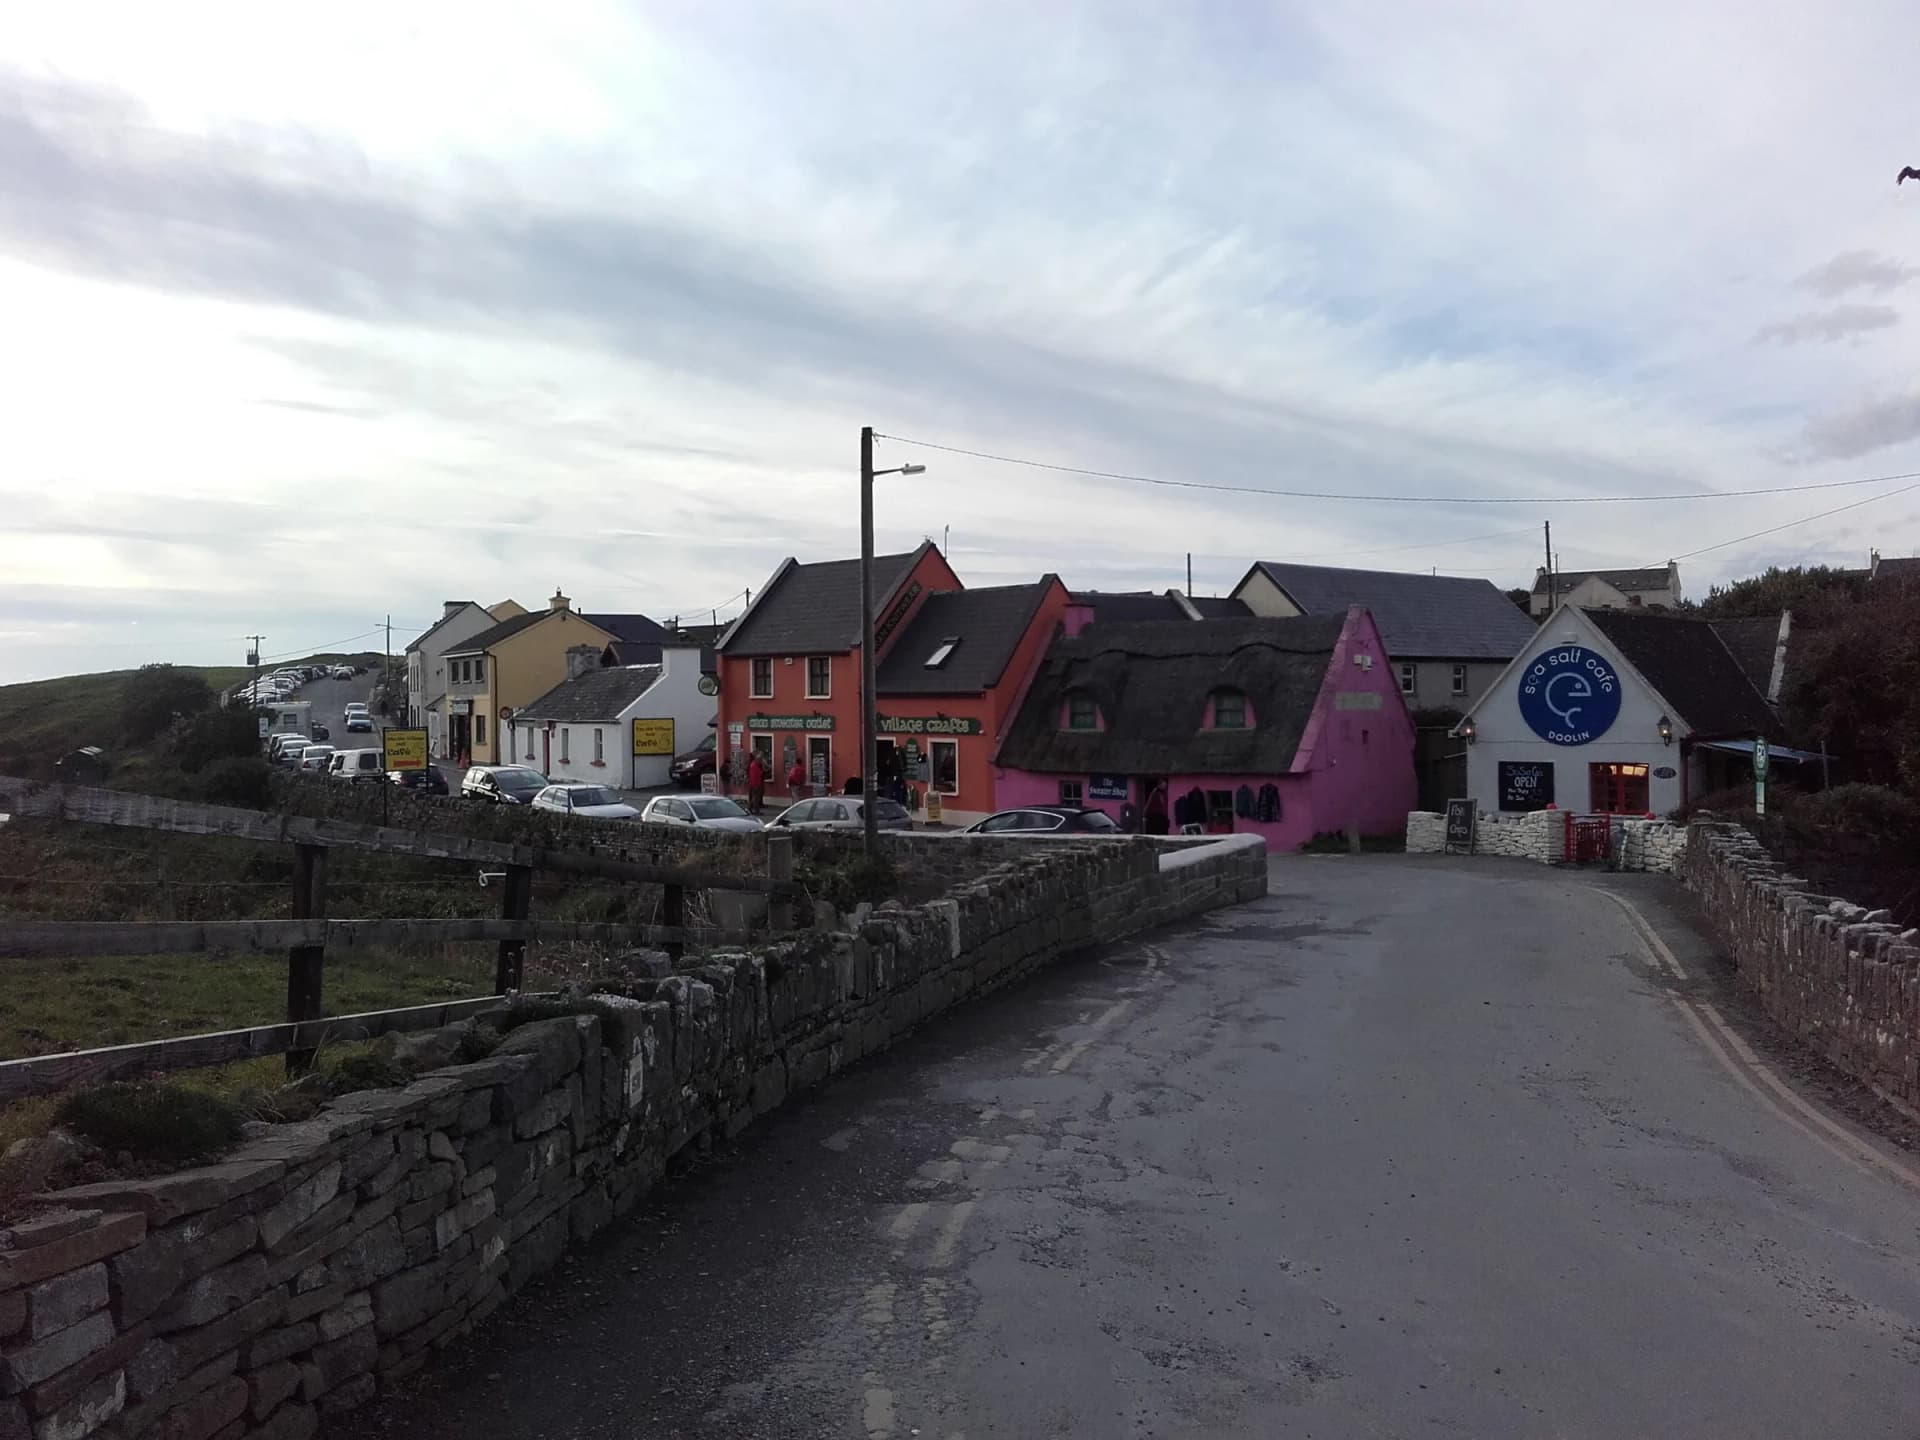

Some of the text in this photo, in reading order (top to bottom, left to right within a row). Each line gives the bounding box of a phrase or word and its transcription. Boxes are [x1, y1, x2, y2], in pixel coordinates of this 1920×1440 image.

[1549, 648, 1580, 665] salt
[1586, 659, 1614, 693] cafe
[1548, 731, 1590, 742] DOOLIN
[1514, 776, 1537, 788] OPEN
